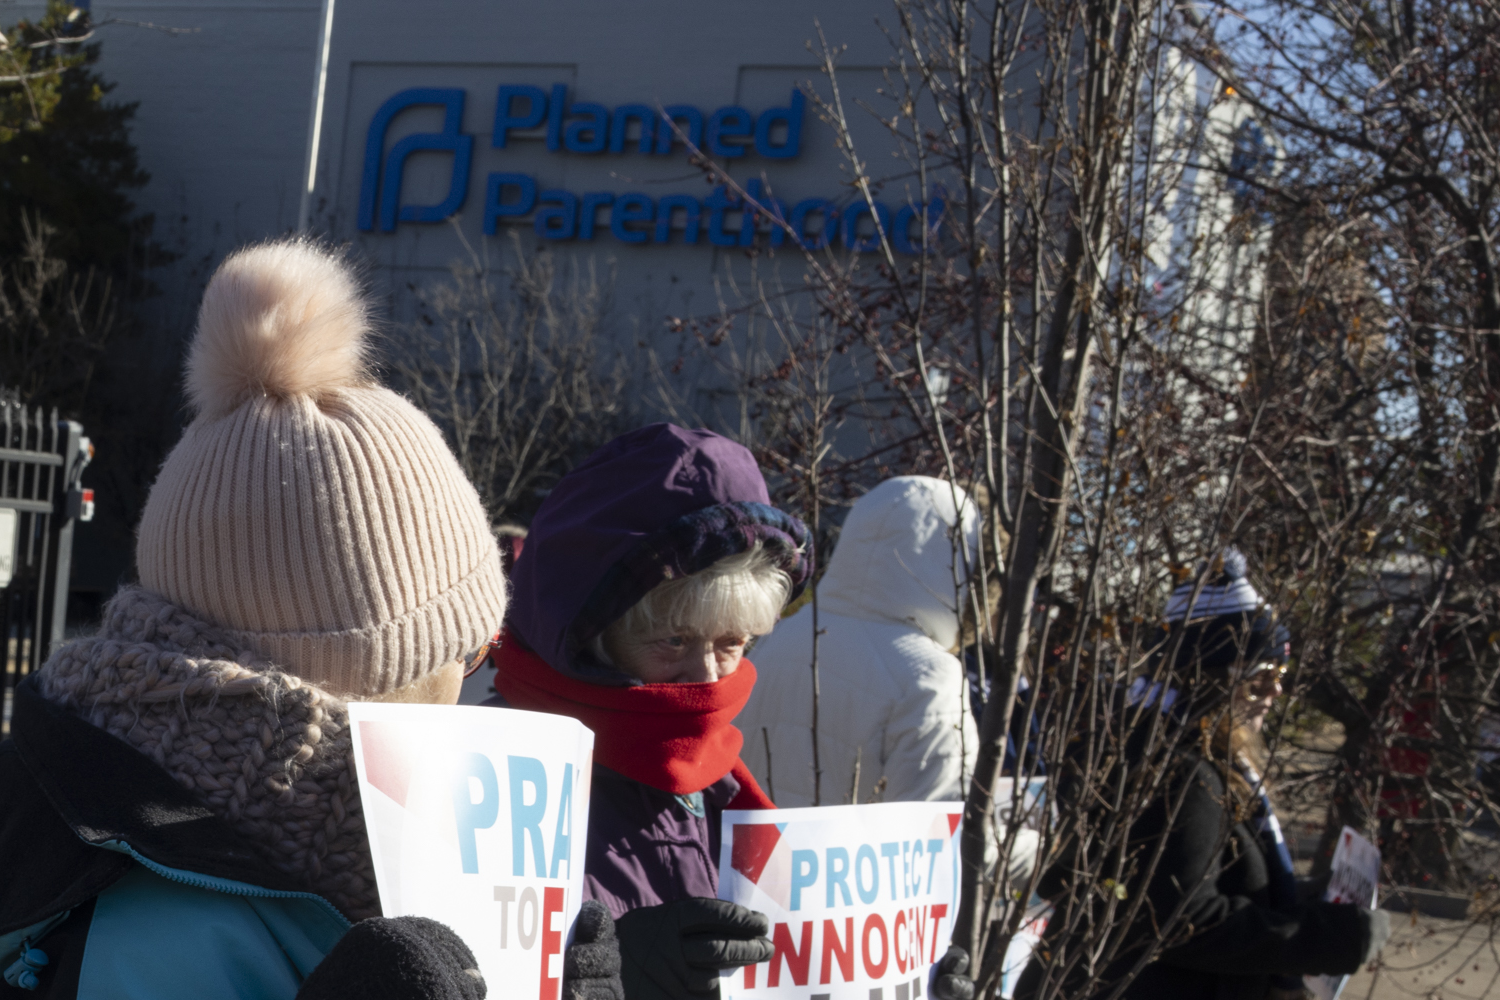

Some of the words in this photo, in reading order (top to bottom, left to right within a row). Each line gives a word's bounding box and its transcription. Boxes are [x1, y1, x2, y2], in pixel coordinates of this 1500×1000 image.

[493, 83, 802, 158] Planned
[483, 172, 948, 254] Parenthood
[452, 752, 580, 880] PRA
[789, 838, 944, 912] PROTECT
[493, 885, 539, 950] TO
